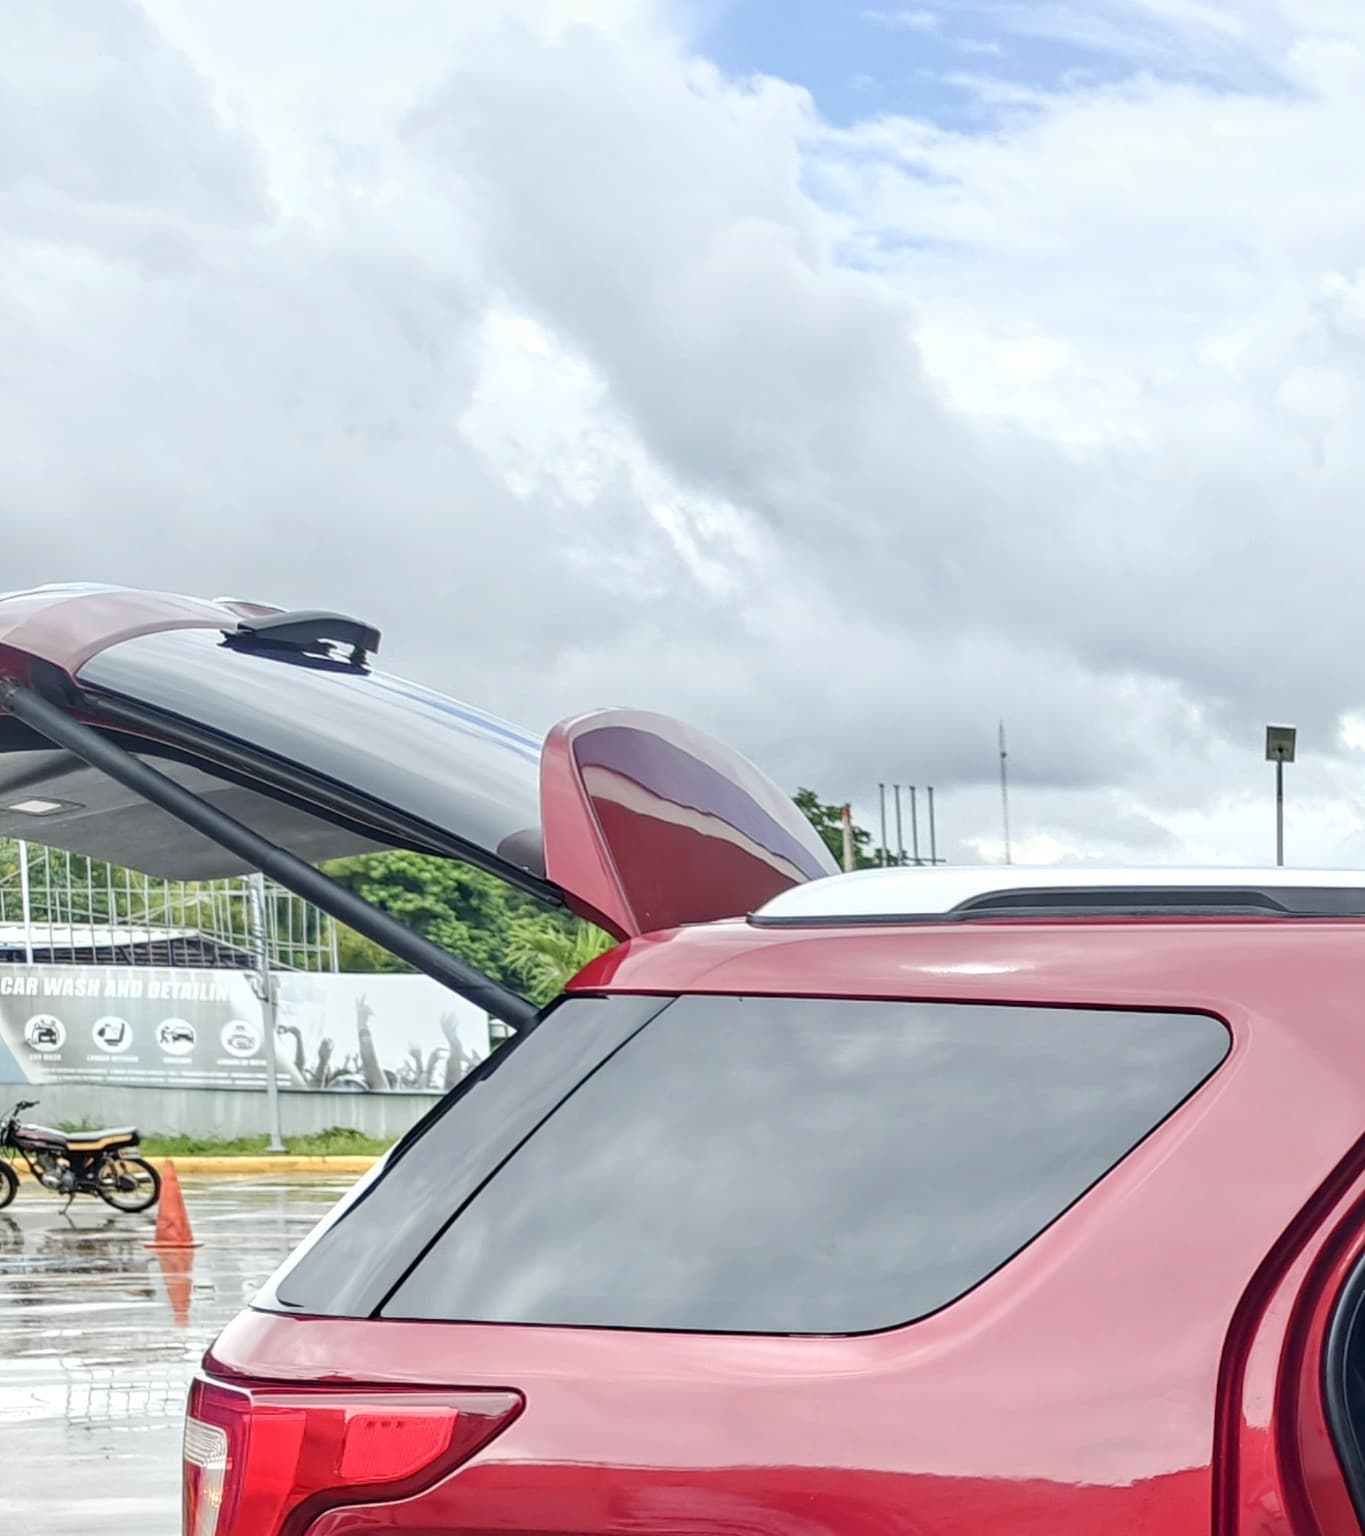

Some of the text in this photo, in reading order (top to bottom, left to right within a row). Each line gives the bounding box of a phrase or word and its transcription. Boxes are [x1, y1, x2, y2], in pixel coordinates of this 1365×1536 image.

[1, 976, 39, 996] CAR
[44, 977, 100, 997] WASH
[104, 978, 143, 999] AND
